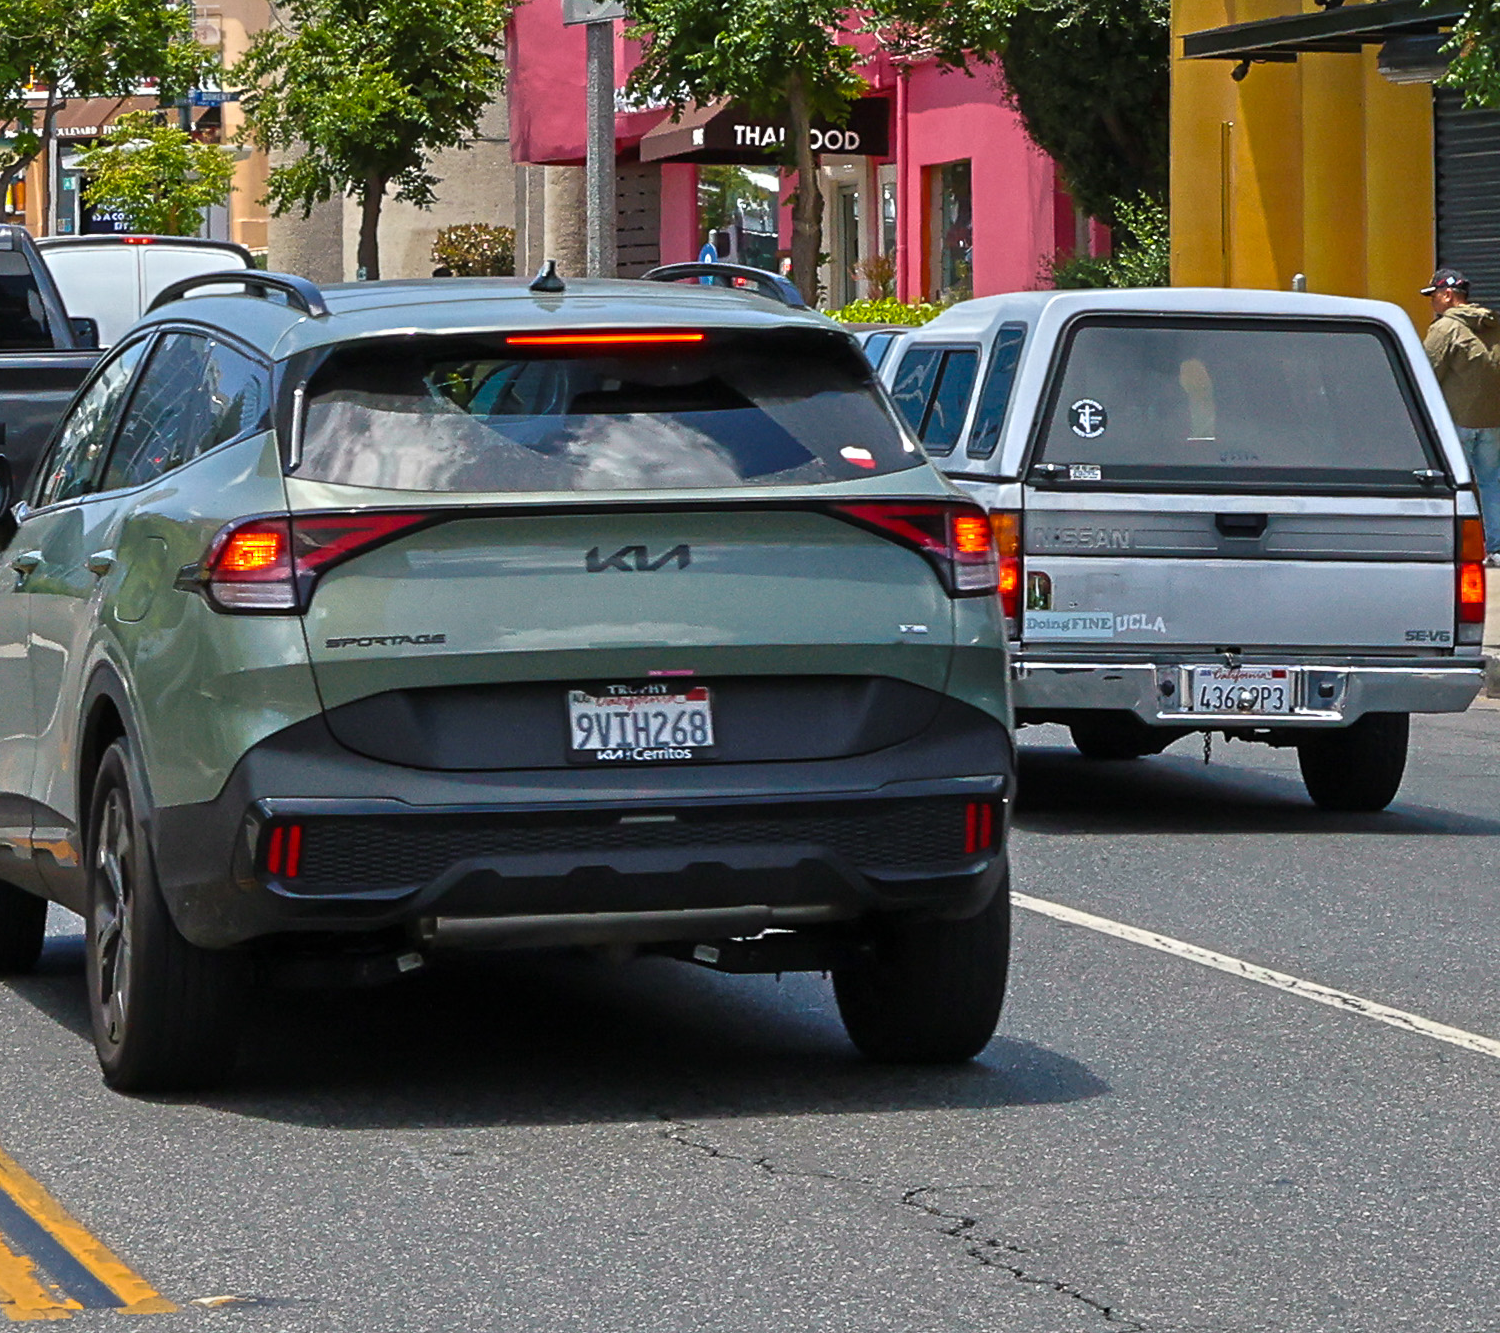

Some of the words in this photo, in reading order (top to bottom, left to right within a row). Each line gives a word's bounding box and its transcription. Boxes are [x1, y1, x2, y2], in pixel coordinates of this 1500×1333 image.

[734, 124, 786, 147] THAI
[810, 129, 861, 151] OOD
[1034, 527, 1131, 550] NISSAN
[585, 543, 691, 573] KIA
[1114, 613, 1168, 634] UCLA
[325, 633, 447, 649] SPORTAGE
[1404, 629, 1451, 643] SE-V6
[1212, 667, 1271, 685] California
[575, 710, 708, 750] 9VIH268
